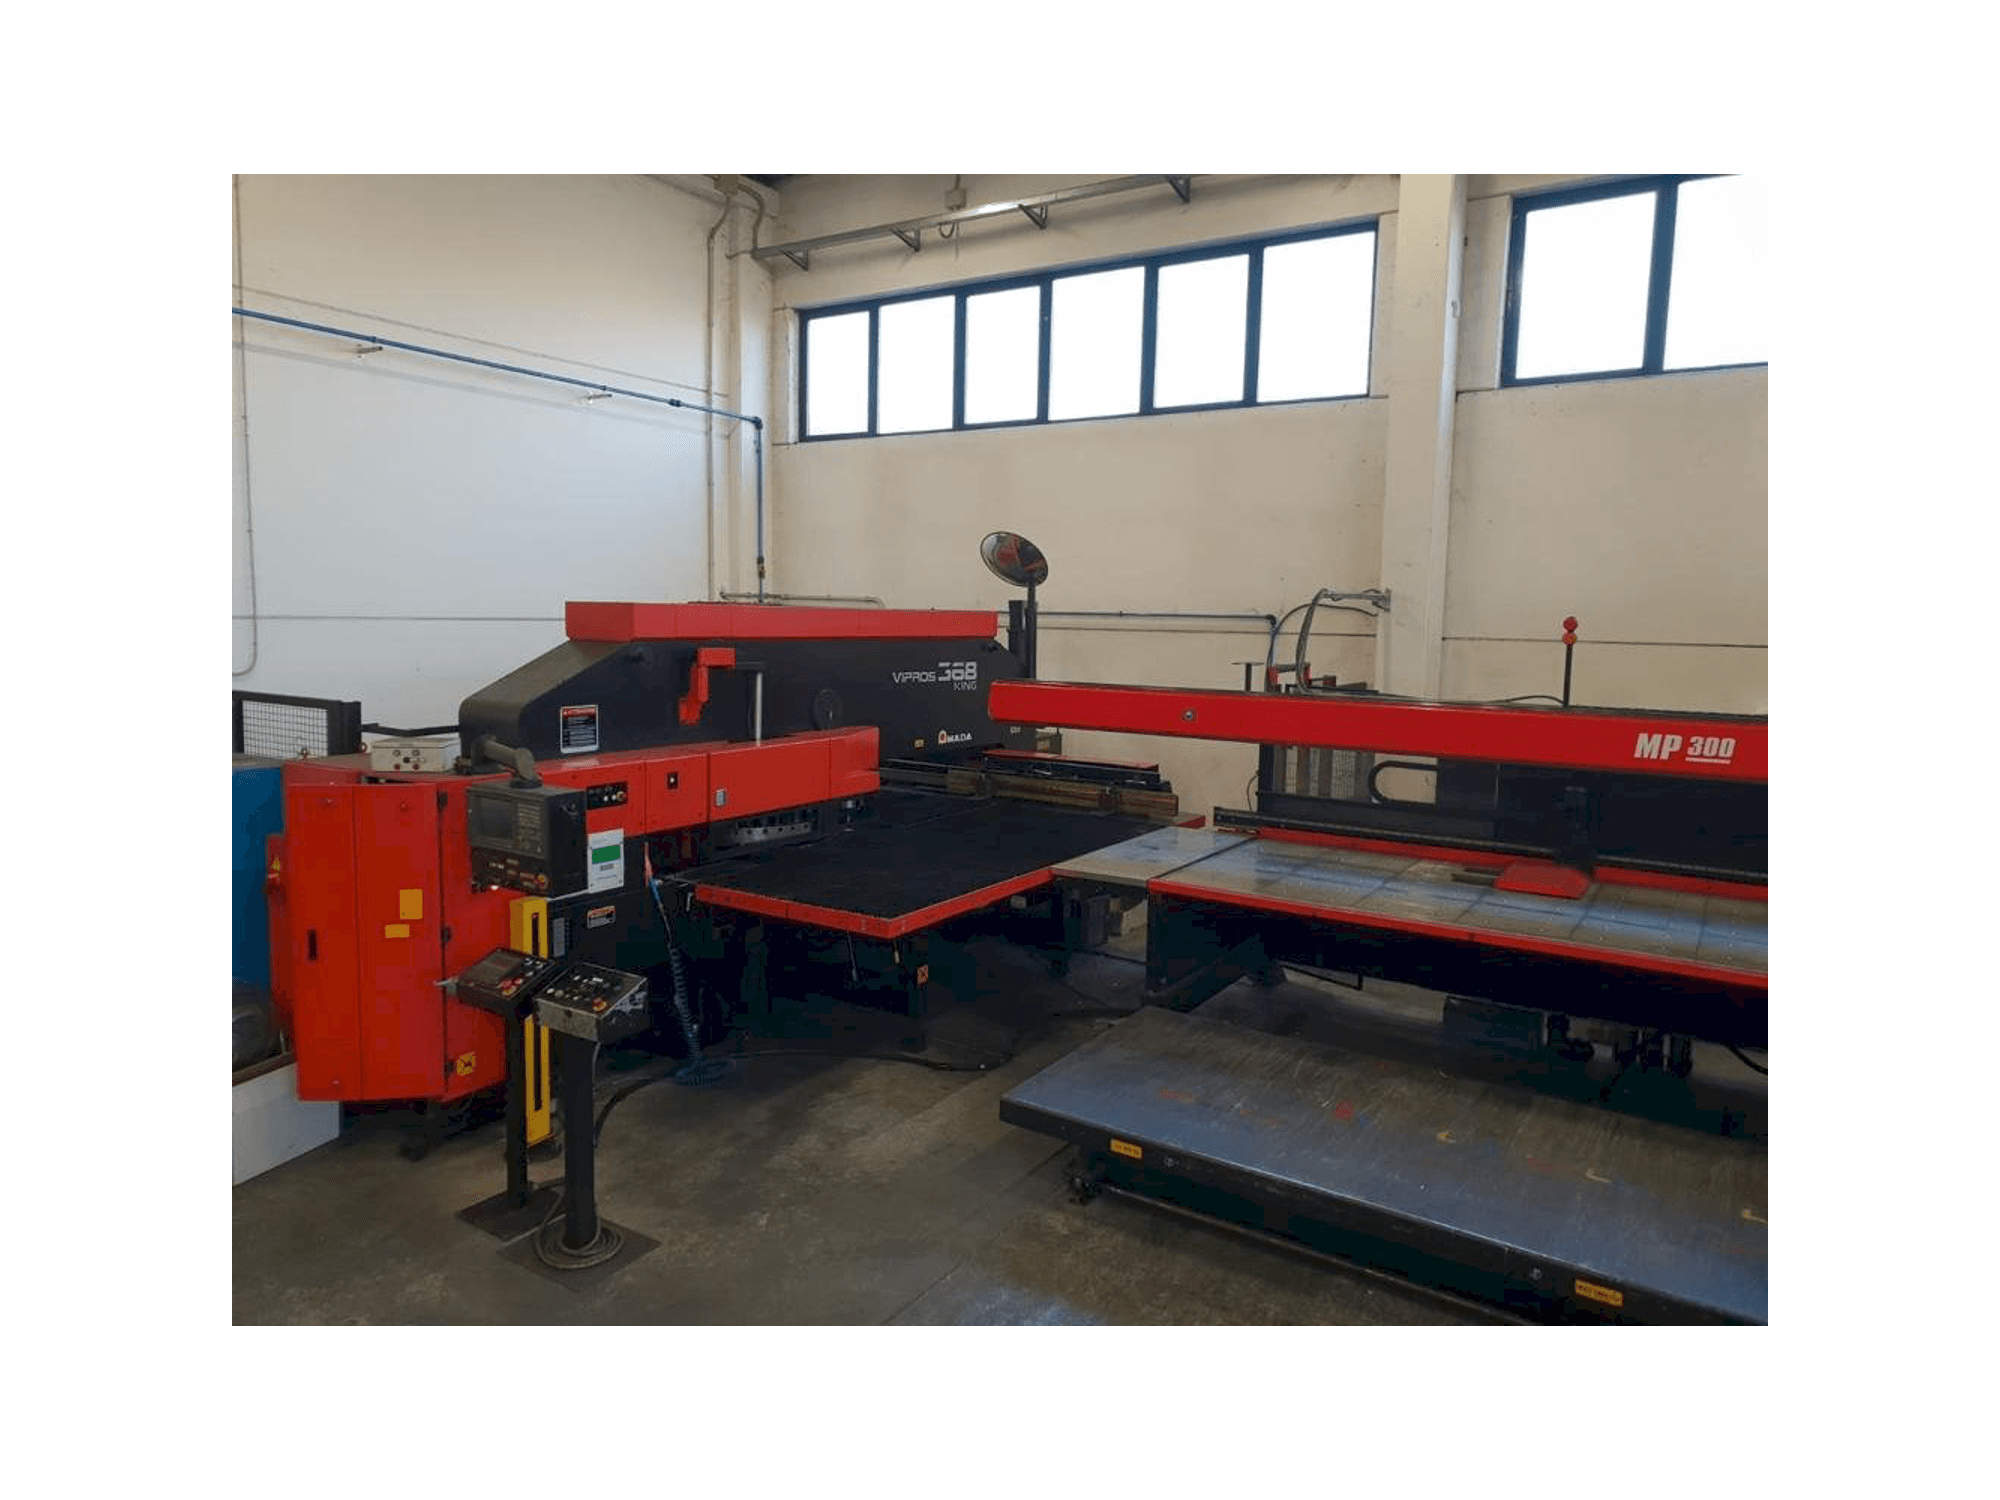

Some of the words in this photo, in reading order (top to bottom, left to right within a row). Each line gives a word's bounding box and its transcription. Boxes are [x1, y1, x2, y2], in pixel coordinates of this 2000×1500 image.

[892, 671, 936, 683] VIPROS
[938, 661, 977, 681] 368
[953, 681, 977, 690] KING
[1634, 733, 1683, 760] MP
[1686, 736, 1736, 758] 300
